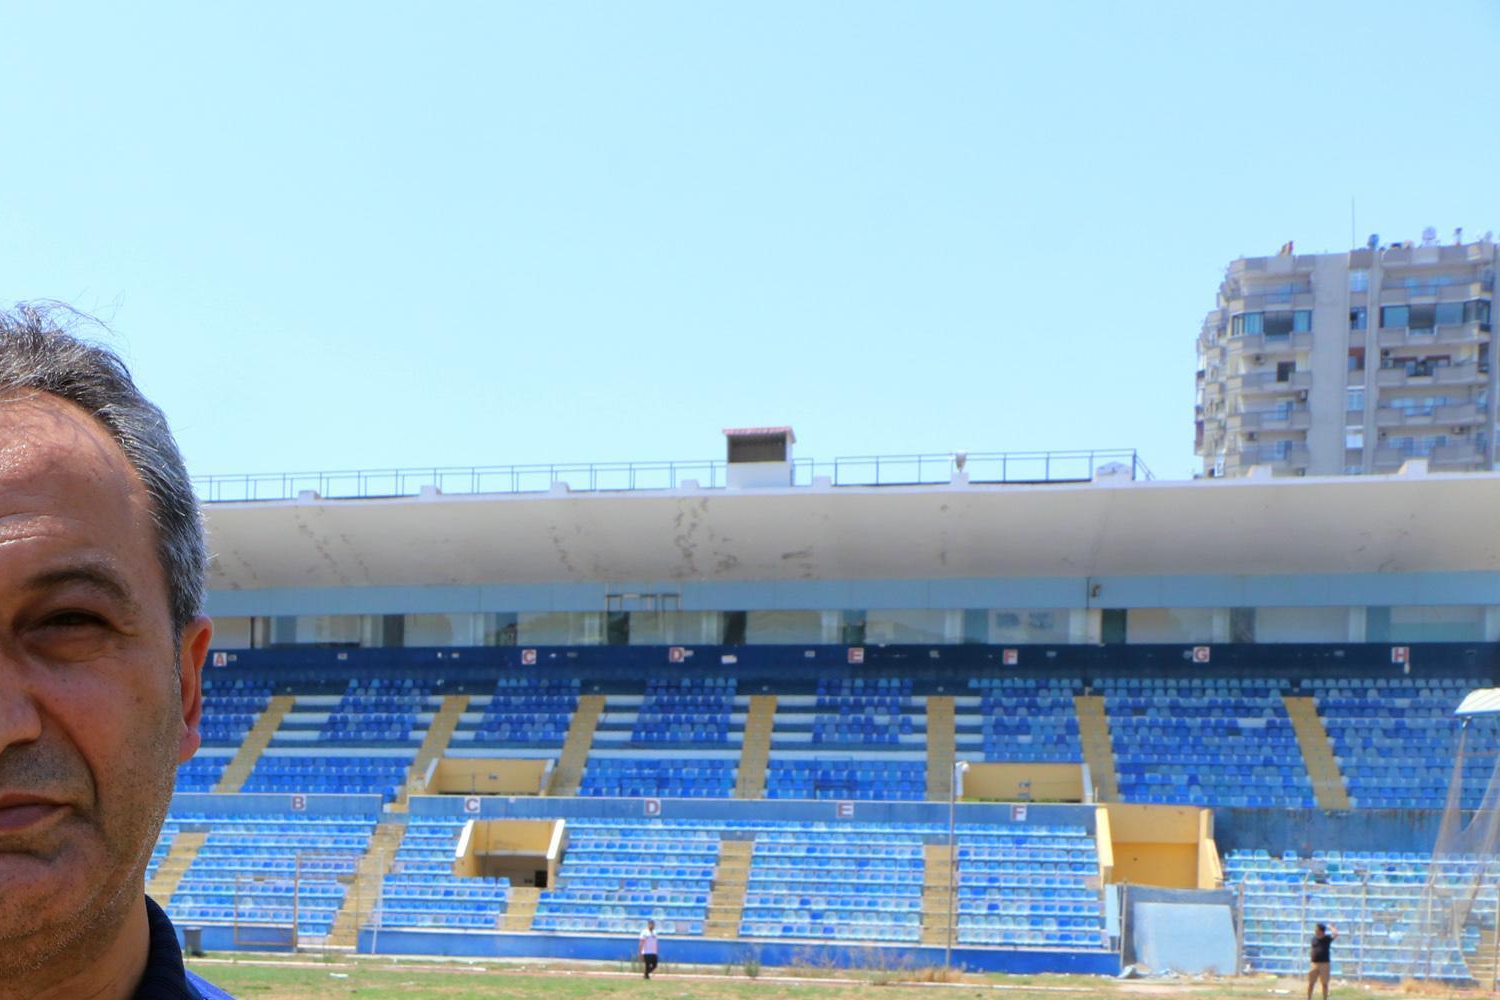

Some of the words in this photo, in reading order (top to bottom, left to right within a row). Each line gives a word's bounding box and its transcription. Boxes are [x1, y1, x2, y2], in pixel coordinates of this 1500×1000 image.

[215, 652, 225, 665] A
[522, 649, 534, 663] C
[670, 648, 682, 662] D
[849, 648, 862, 662] E
[1003, 649, 1016, 664] F
[1195, 648, 1208, 662] G
[1395, 647, 1409, 661] H
[292, 796, 305, 810] B
[466, 798, 479, 812] C
[645, 799, 660, 815] D
[838, 802, 852, 818] E
[1012, 805, 1026, 820] F
